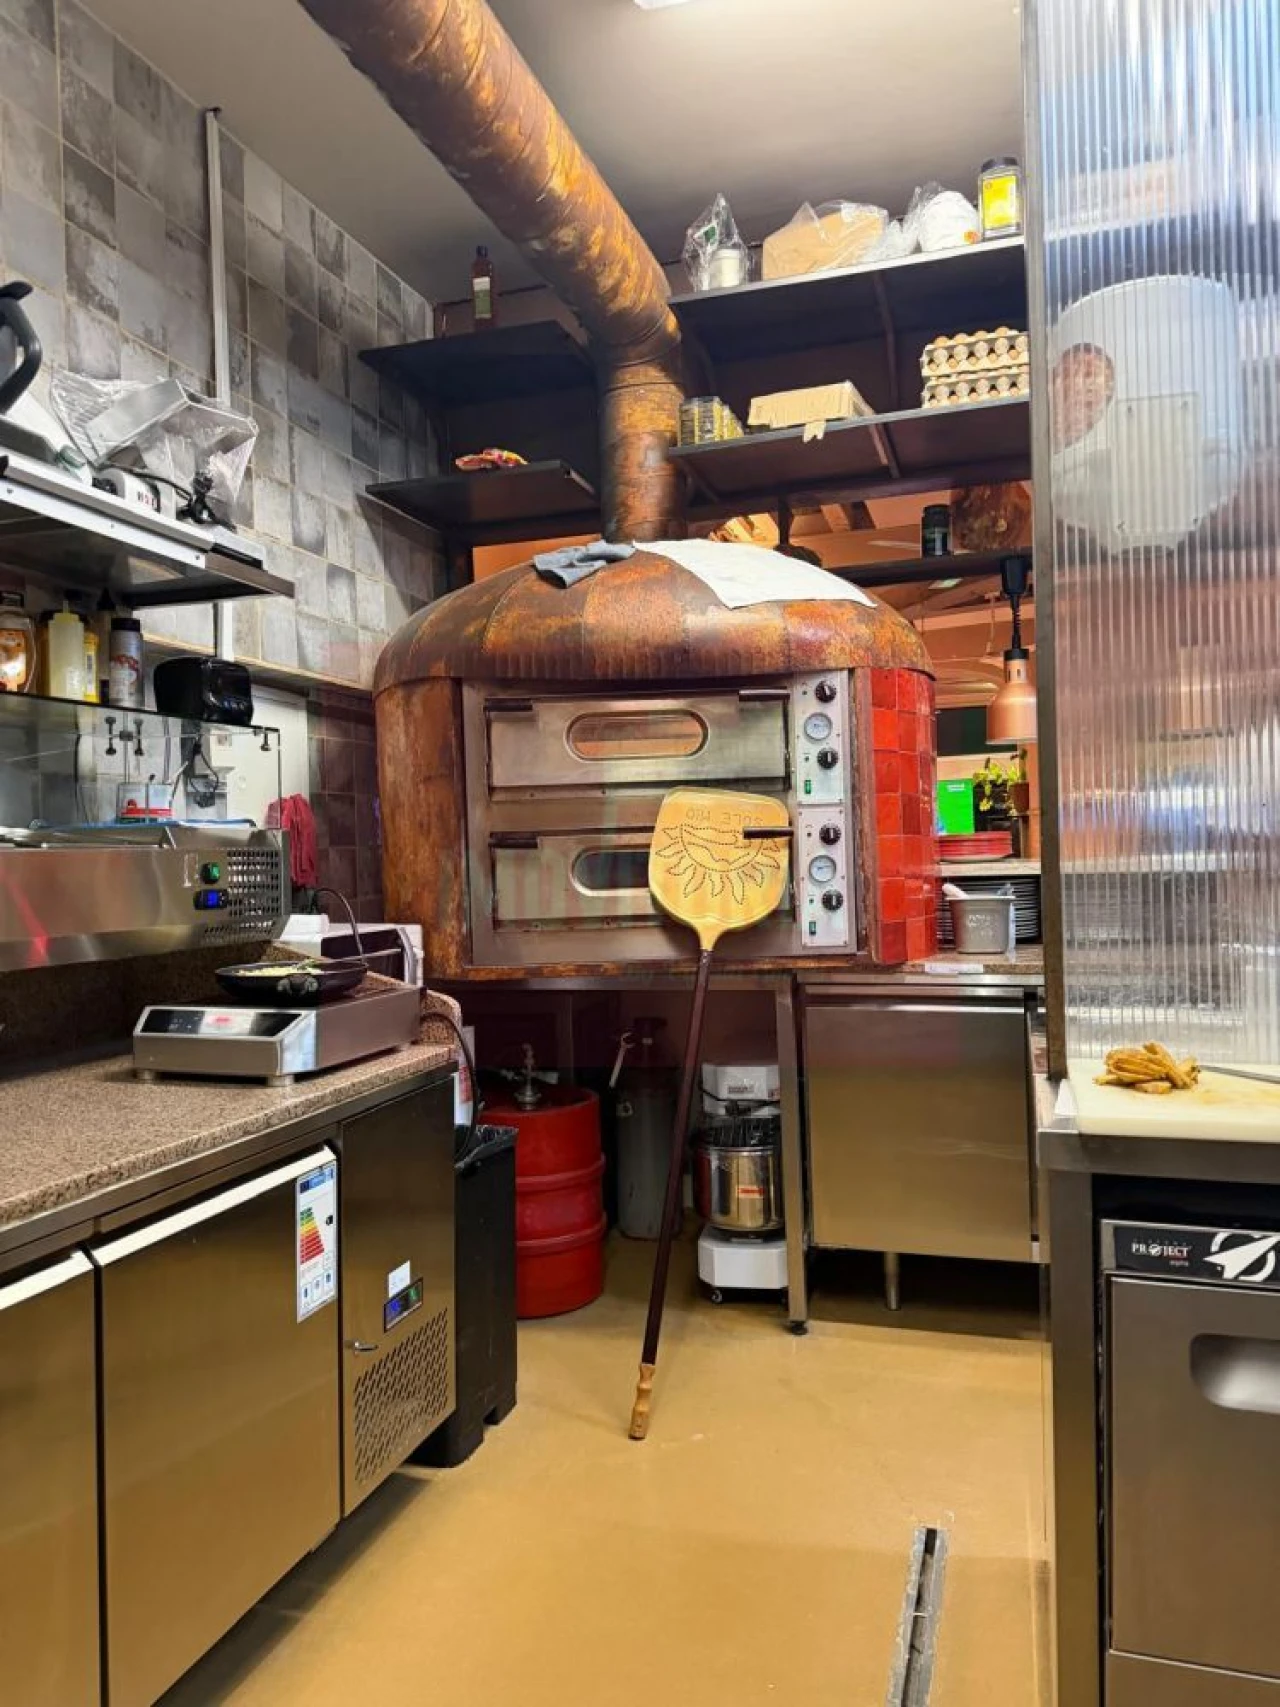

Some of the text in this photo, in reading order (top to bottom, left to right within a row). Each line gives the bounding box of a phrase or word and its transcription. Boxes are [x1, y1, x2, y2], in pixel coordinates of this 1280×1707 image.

[685, 807, 764, 827] SOLE MIO
[1131, 1242, 1190, 1257] PROJECT
